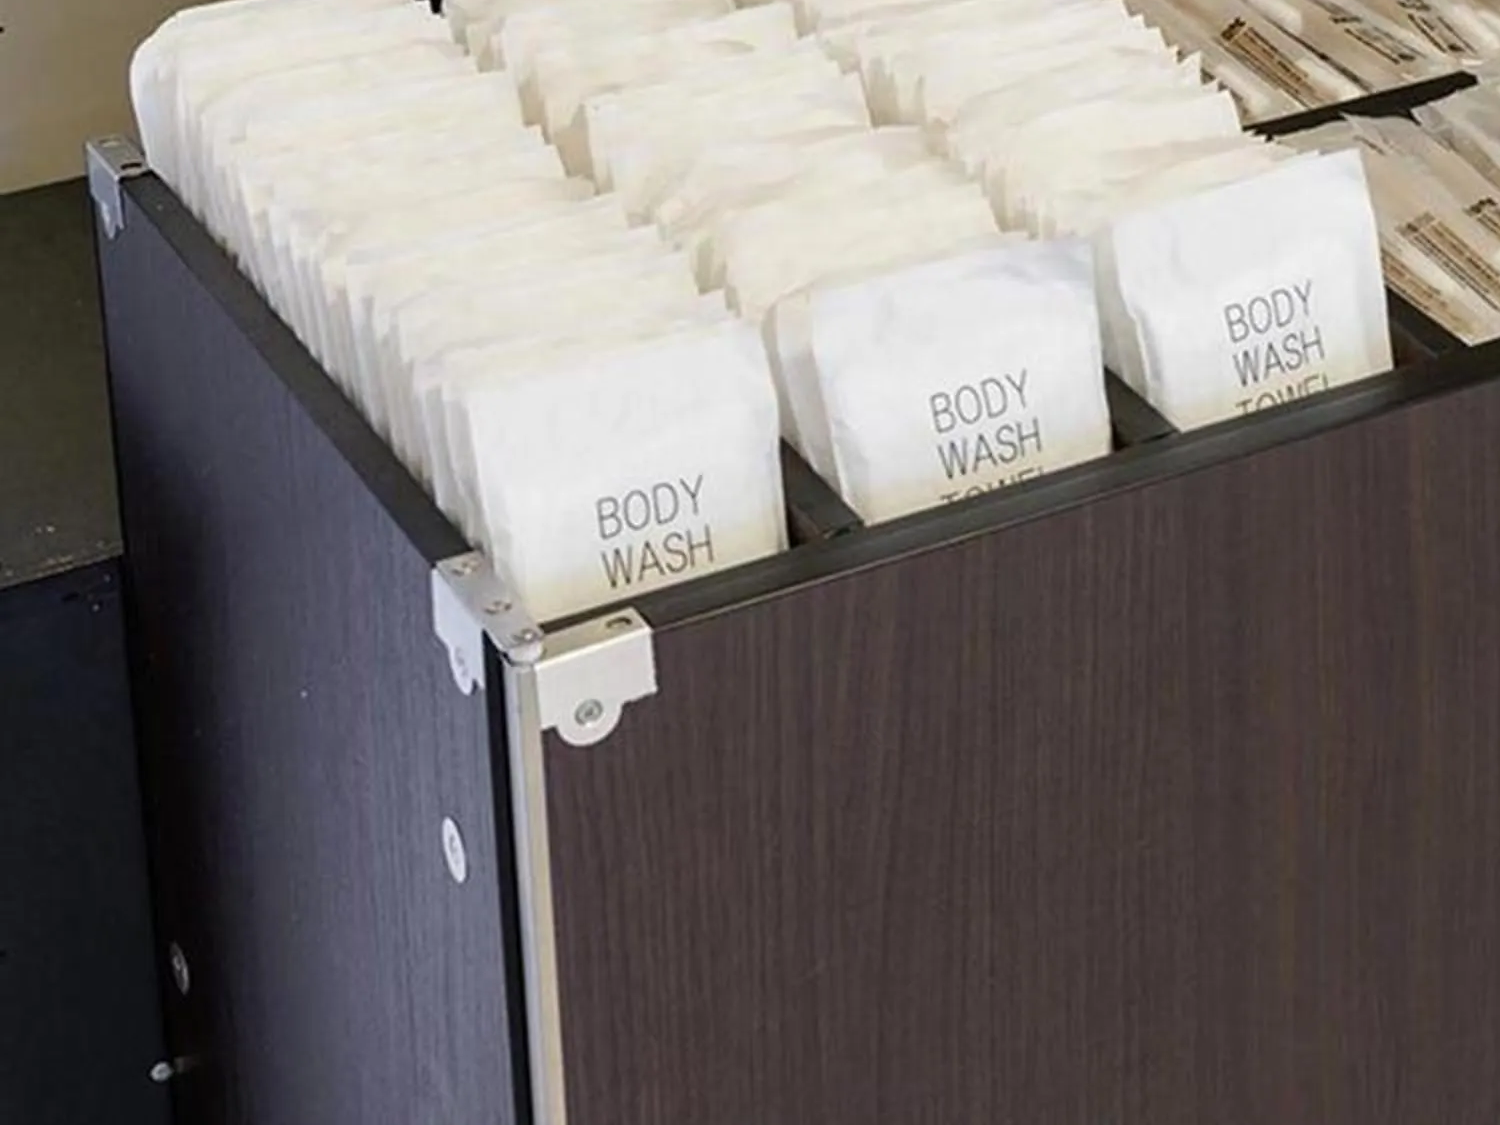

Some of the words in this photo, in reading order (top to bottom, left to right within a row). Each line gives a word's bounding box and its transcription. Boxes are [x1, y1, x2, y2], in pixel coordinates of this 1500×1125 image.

[1224, 280, 1311, 343] BODY
[1232, 326, 1325, 387] WASH
[930, 369, 1027, 434] BODY
[937, 416, 1041, 479] WASH
[597, 474, 703, 540] BODY
[601, 524, 714, 589] WASH
